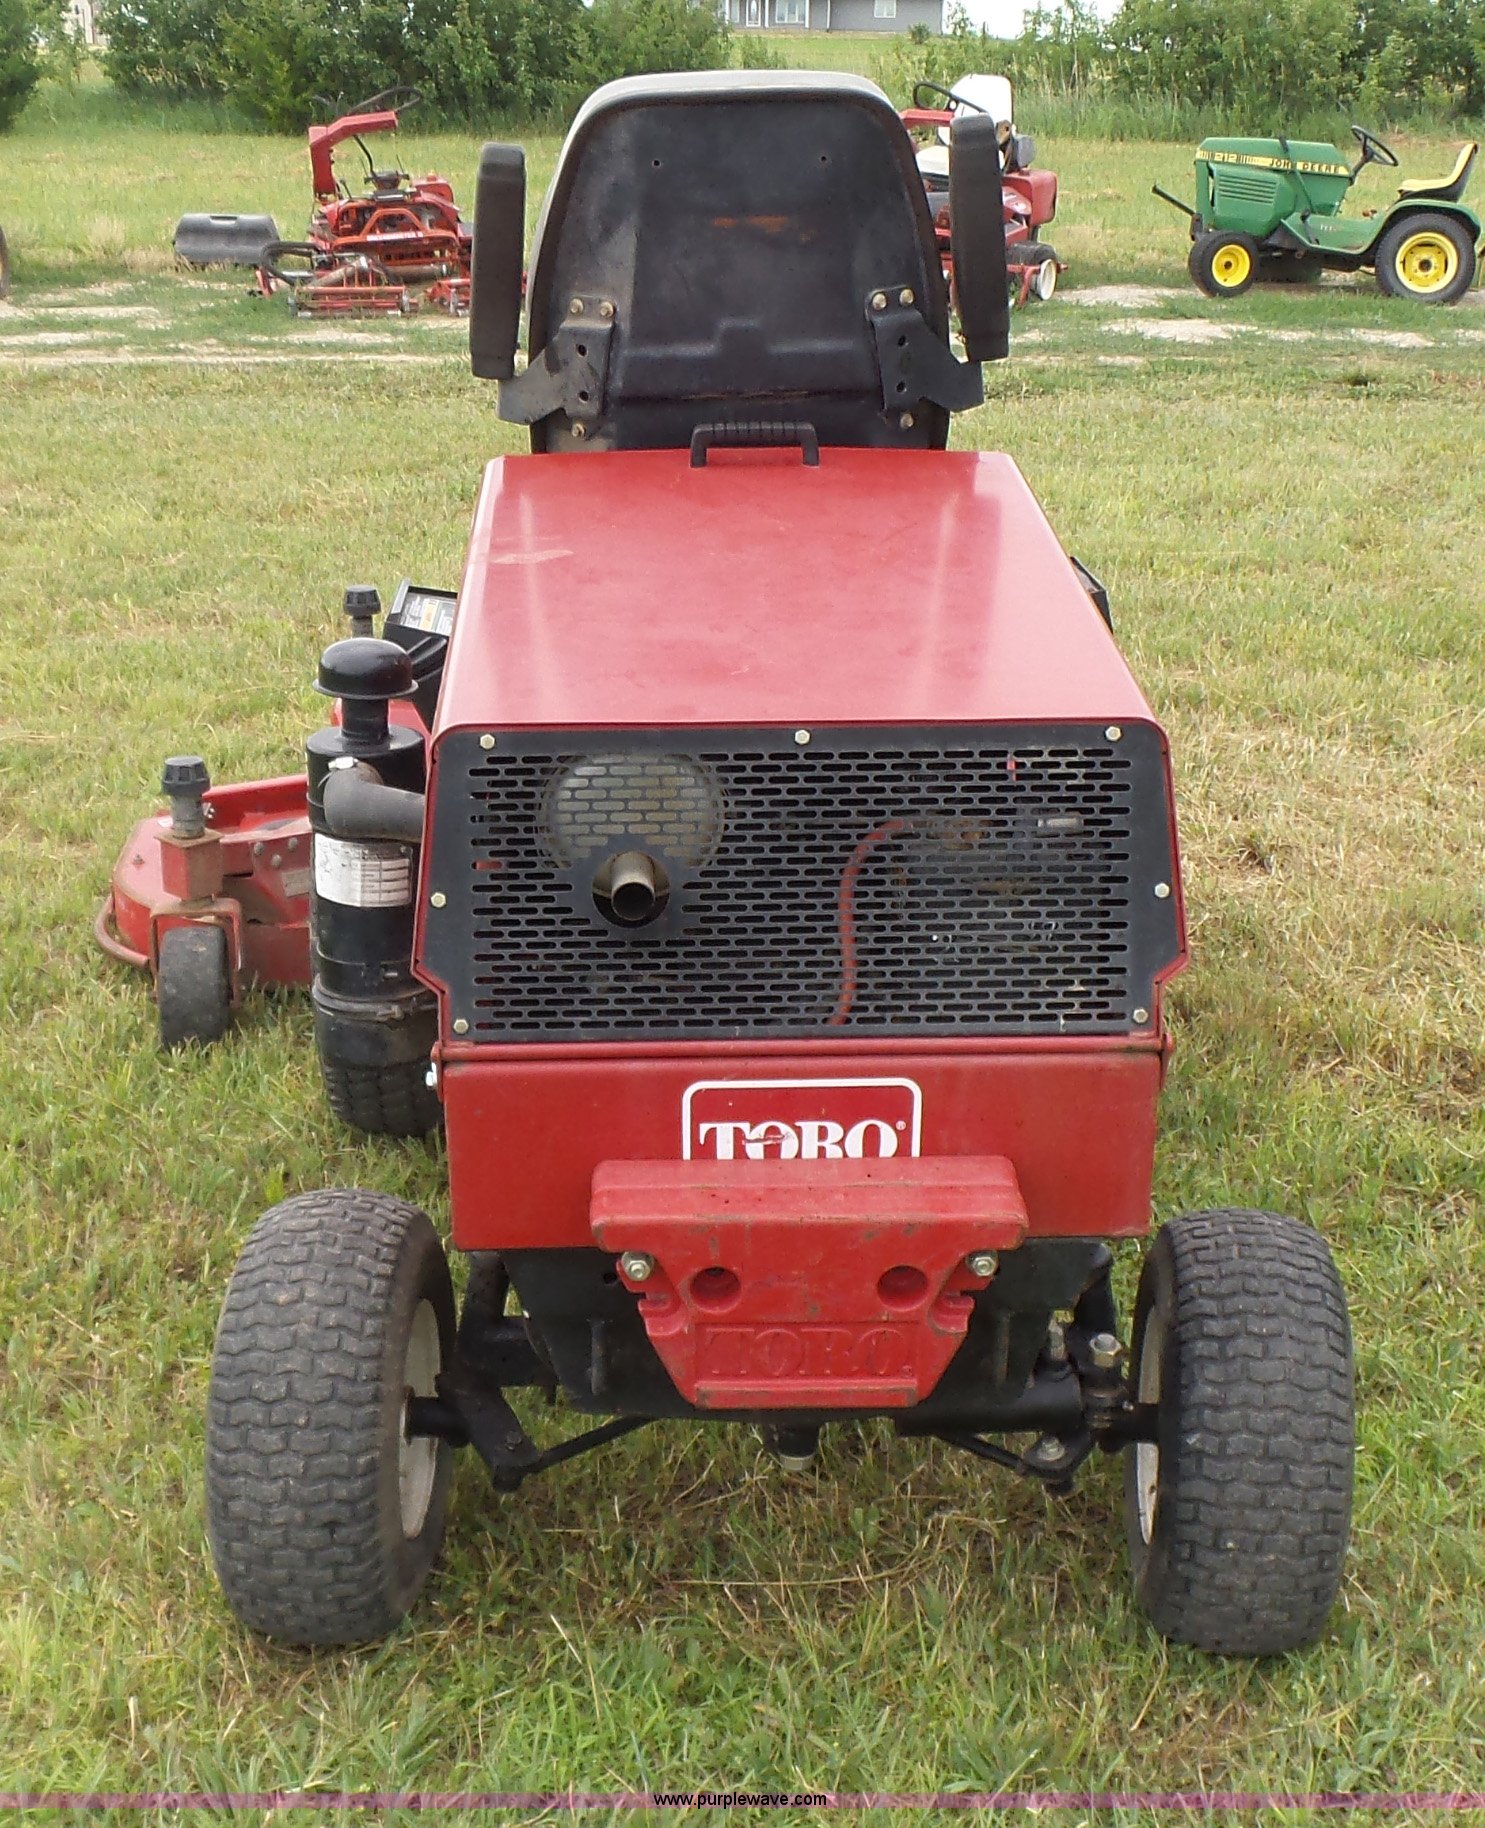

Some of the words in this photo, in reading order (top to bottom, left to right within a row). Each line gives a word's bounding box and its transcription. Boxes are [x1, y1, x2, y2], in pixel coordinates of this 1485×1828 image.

[1270, 158, 1294, 170] JOH
[1303, 162, 1340, 174] DEERE
[699, 1119, 898, 1159] TORO
[705, 1327, 904, 1376] TORO
